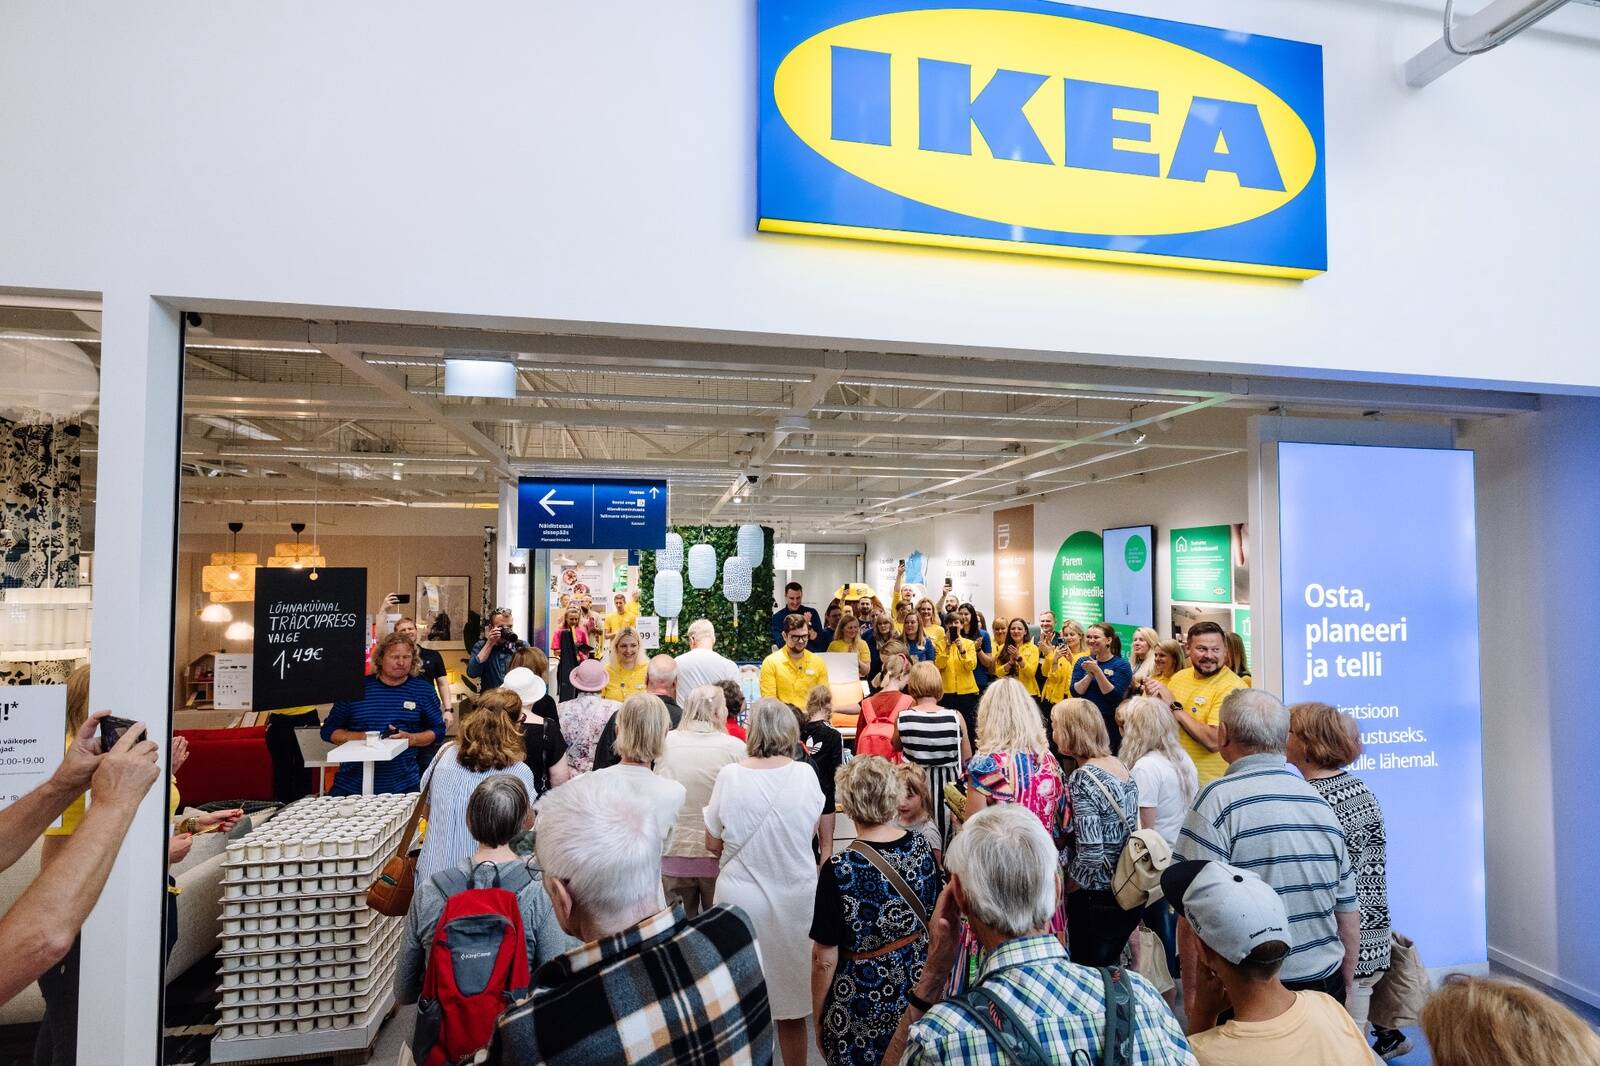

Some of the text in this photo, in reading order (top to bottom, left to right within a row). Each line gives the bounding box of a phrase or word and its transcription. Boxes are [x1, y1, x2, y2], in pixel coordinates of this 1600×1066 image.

[830, 45, 1287, 193] IKEA
[1062, 556, 1082, 566] Parem
[1062, 571, 1096, 582] inimestele
[1304, 583, 1370, 611] Osta,
[269, 600, 340, 614] LÕHNAKÜÜNAL
[269, 613, 356, 631] TRÄDCYPRESS
[268, 632, 300, 643] VALGE
[1306, 617, 1407, 650] planeeri
[1304, 651, 1382, 685] ja telli
[1358, 727, 1427, 744] ustuseks.
[1380, 751, 1438, 769] lähemal.
